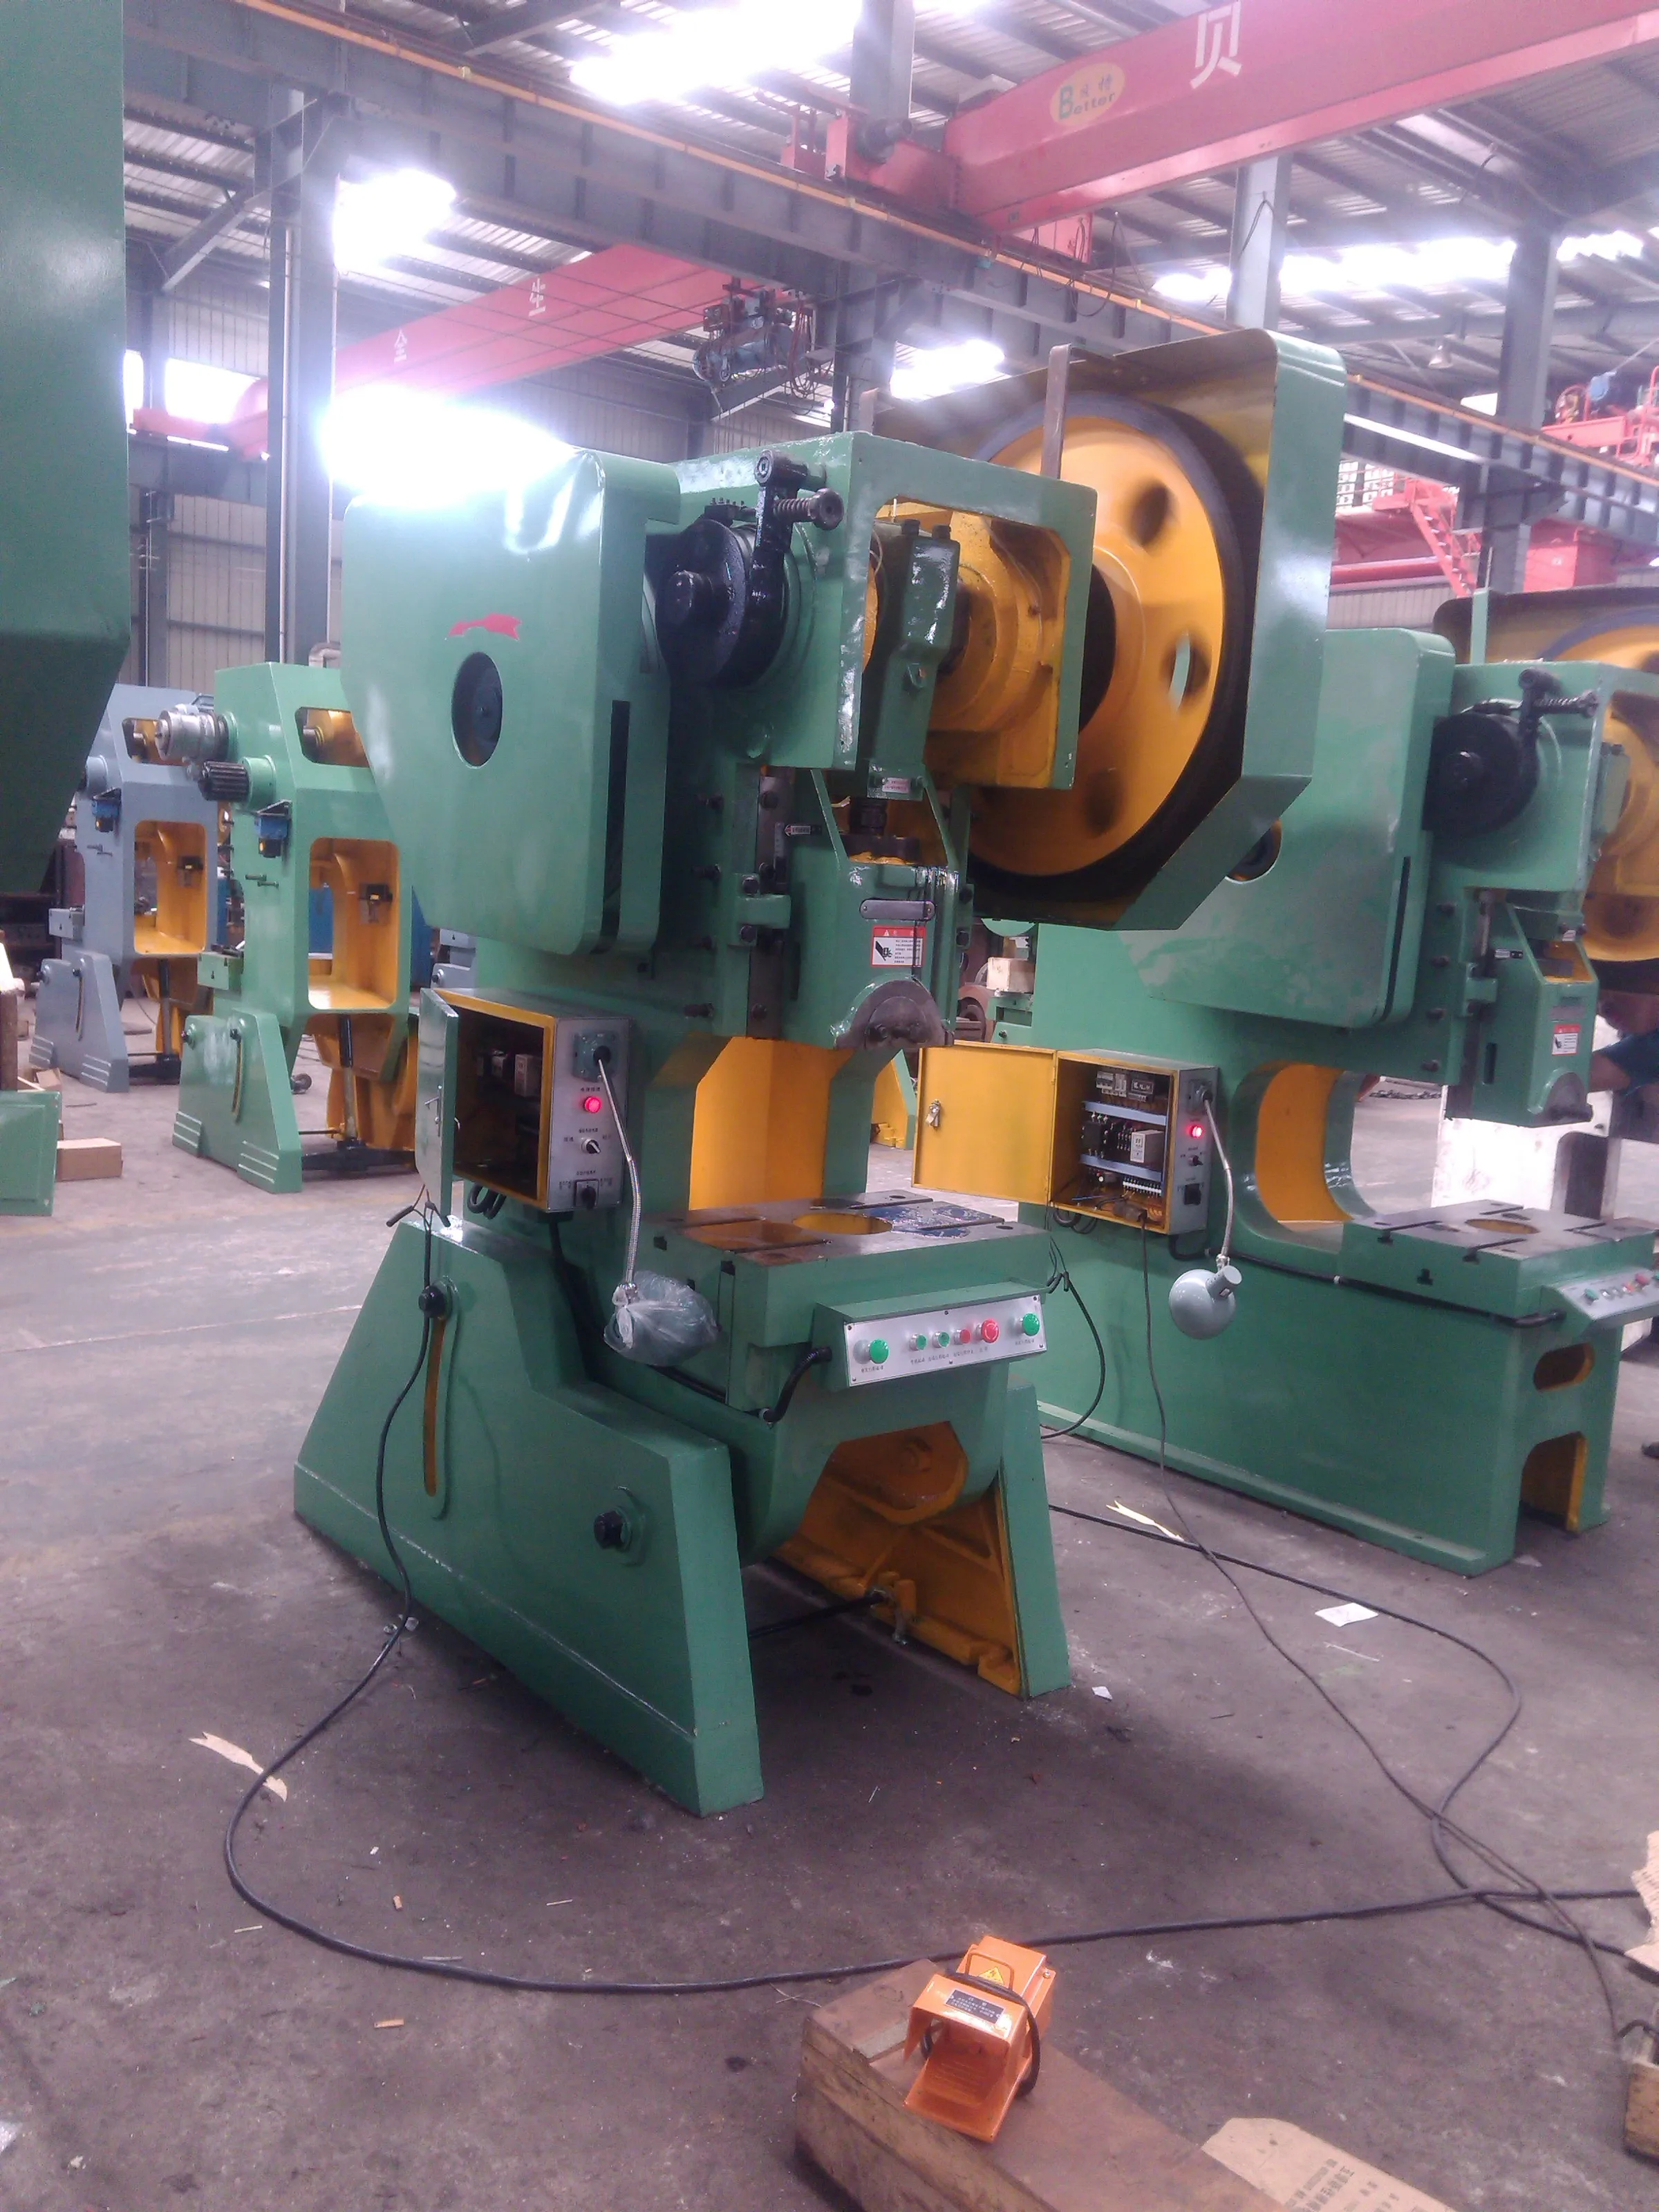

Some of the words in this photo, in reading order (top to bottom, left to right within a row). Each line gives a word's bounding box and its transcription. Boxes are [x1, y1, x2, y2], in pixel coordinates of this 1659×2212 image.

[1190, 0, 1243, 89] 贝
[1059, 84, 1116, 120] Better
[394, 328, 407, 363] 全
[528, 277, 546, 317] 生
